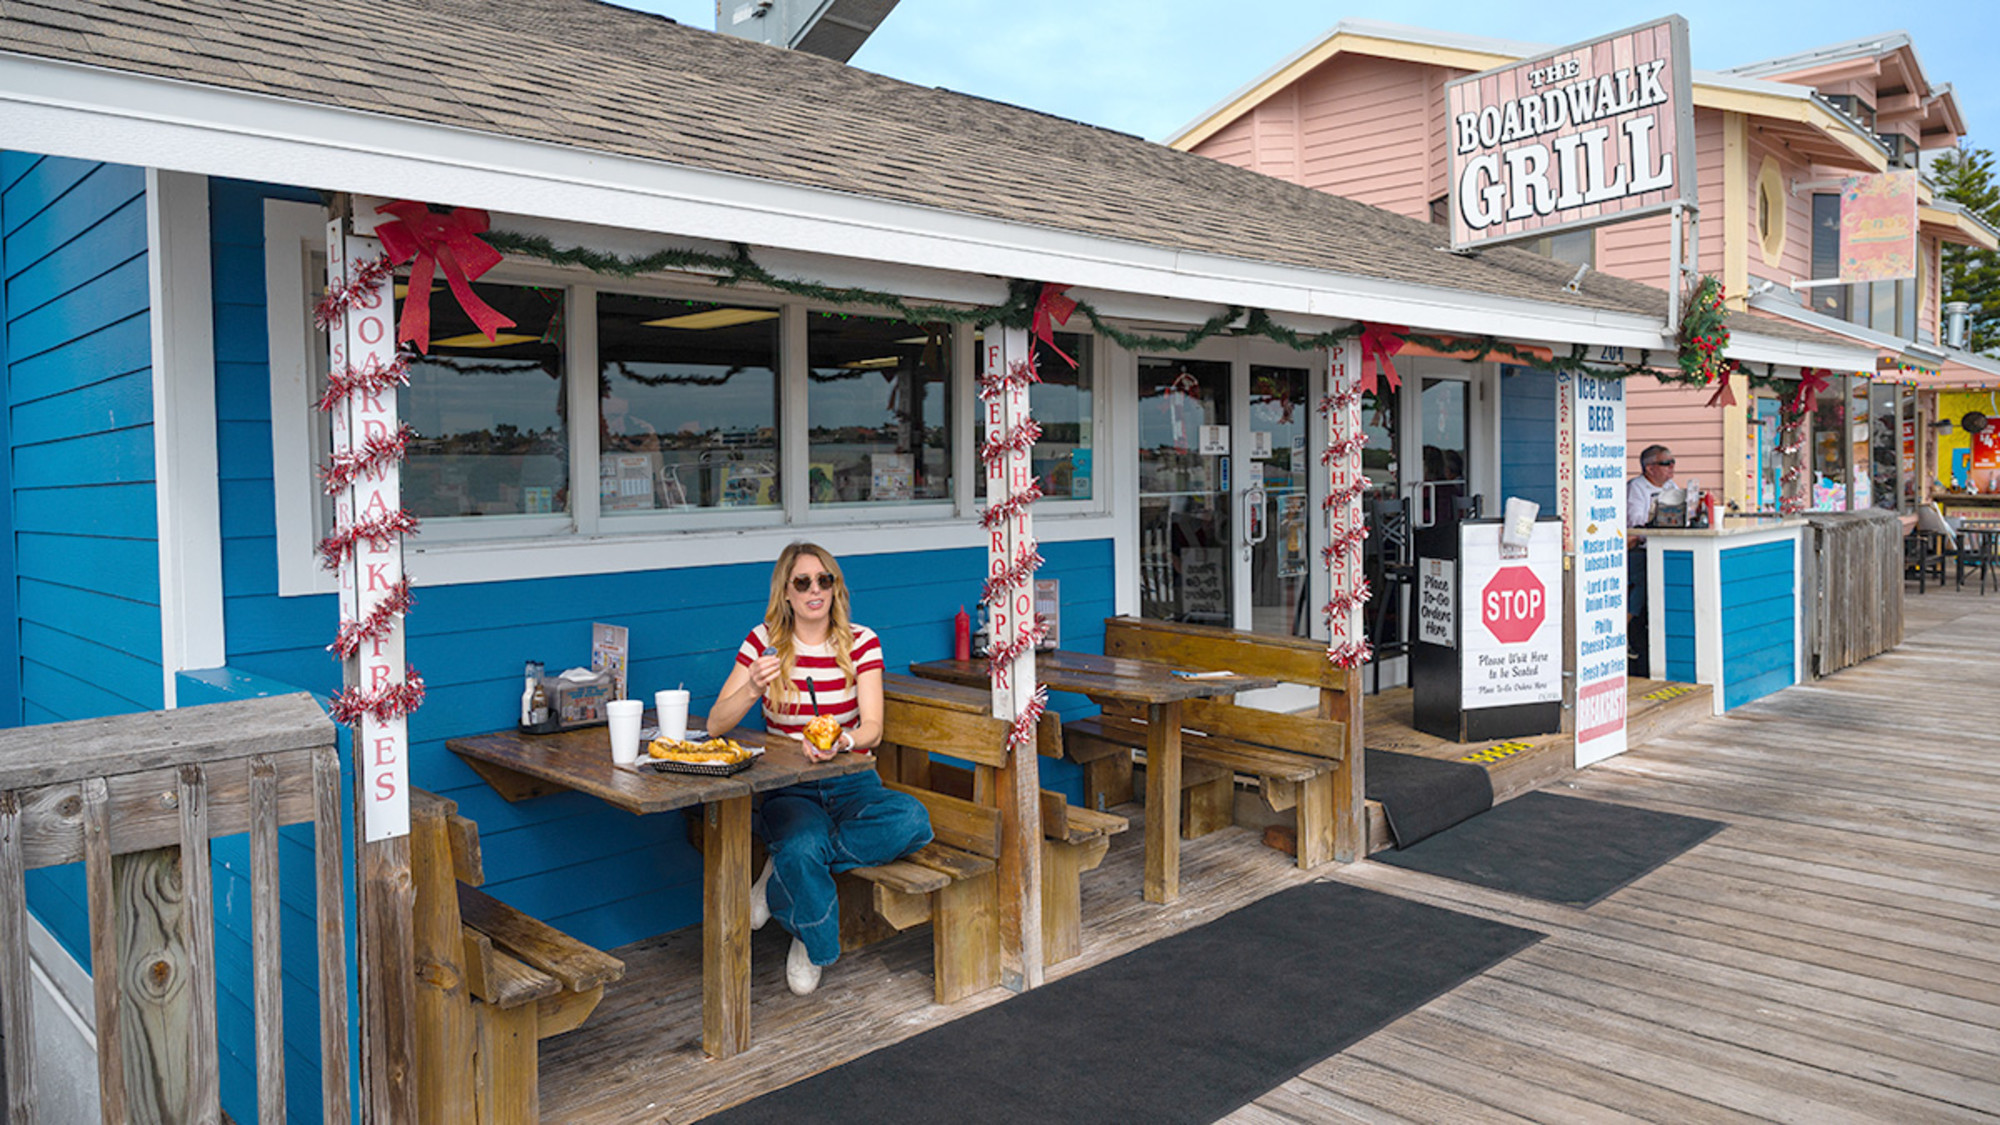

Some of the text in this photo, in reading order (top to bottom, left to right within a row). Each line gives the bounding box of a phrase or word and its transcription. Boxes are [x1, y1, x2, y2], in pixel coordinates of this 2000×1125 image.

[1529, 59, 1580, 88] THE
[1457, 58, 1668, 155] BOARDWALK
[1459, 114, 1673, 230] GRILL
[1601, 346, 1624, 360] 204
[1331, 347, 1344, 441] PHILY
[1578, 373, 1596, 399] Ice
[988, 345, 1004, 480] FESH
[1560, 385, 1569, 423] PLEASE
[1588, 405, 1614, 432] BEER
[1581, 443, 1625, 459] Fresh Grouper
[1560, 462, 1570, 480] FOR
[1584, 465, 1622, 479] Sandwiches
[1594, 485, 1613, 499] Tacos
[1590, 506, 1616, 522] Nuggets
[1583, 539, 1605, 554] Master
[1614, 536, 1624, 550] the
[1611, 552, 1623, 568] Roll
[1424, 575, 1449, 592] Place
[1588, 578, 1601, 595] Lord
[1610, 576, 1620, 590] the
[1423, 590, 1450, 606] To-Go
[1487, 589, 1542, 622] STOP
[1586, 594, 1622, 613] Onion Rings
[1422, 605, 1451, 622] Orders
[1426, 621, 1447, 637] Here
[1595, 618, 1613, 635] Philly
[1581, 633, 1626, 656] Cheese Steaks
[1479, 650, 1548, 667] Please Wait Here
[1489, 664, 1539, 679] to be Seated
[1583, 665, 1599, 682] Fresh
[1610, 658, 1625, 674] Fries
[1578, 685, 1625, 732] BREAKFAST
